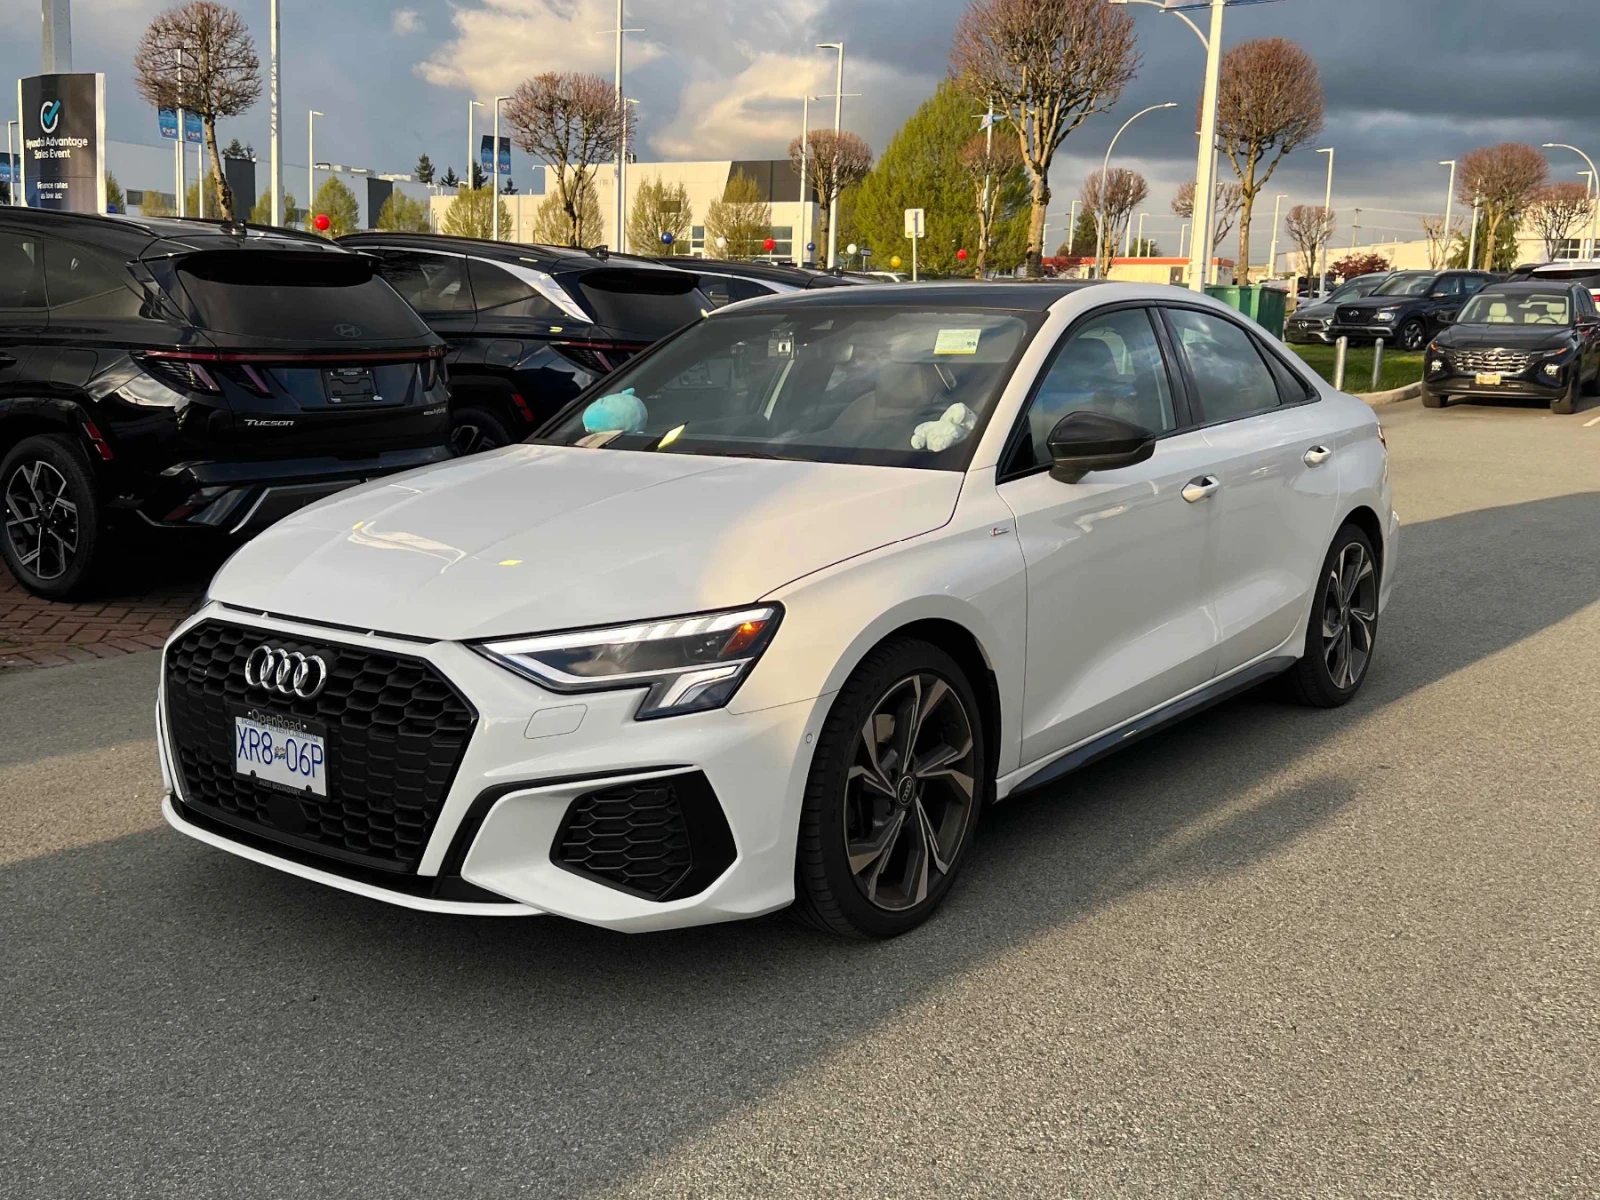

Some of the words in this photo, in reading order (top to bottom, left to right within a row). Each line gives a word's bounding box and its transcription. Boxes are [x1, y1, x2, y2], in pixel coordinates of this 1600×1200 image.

[46, 136, 88, 148] Advantage
[34, 149, 49, 159] Sales
[50, 148, 71, 158] Event
[252, 708, 302, 731] OpenRoad
[259, 779, 272, 788] AUDI
